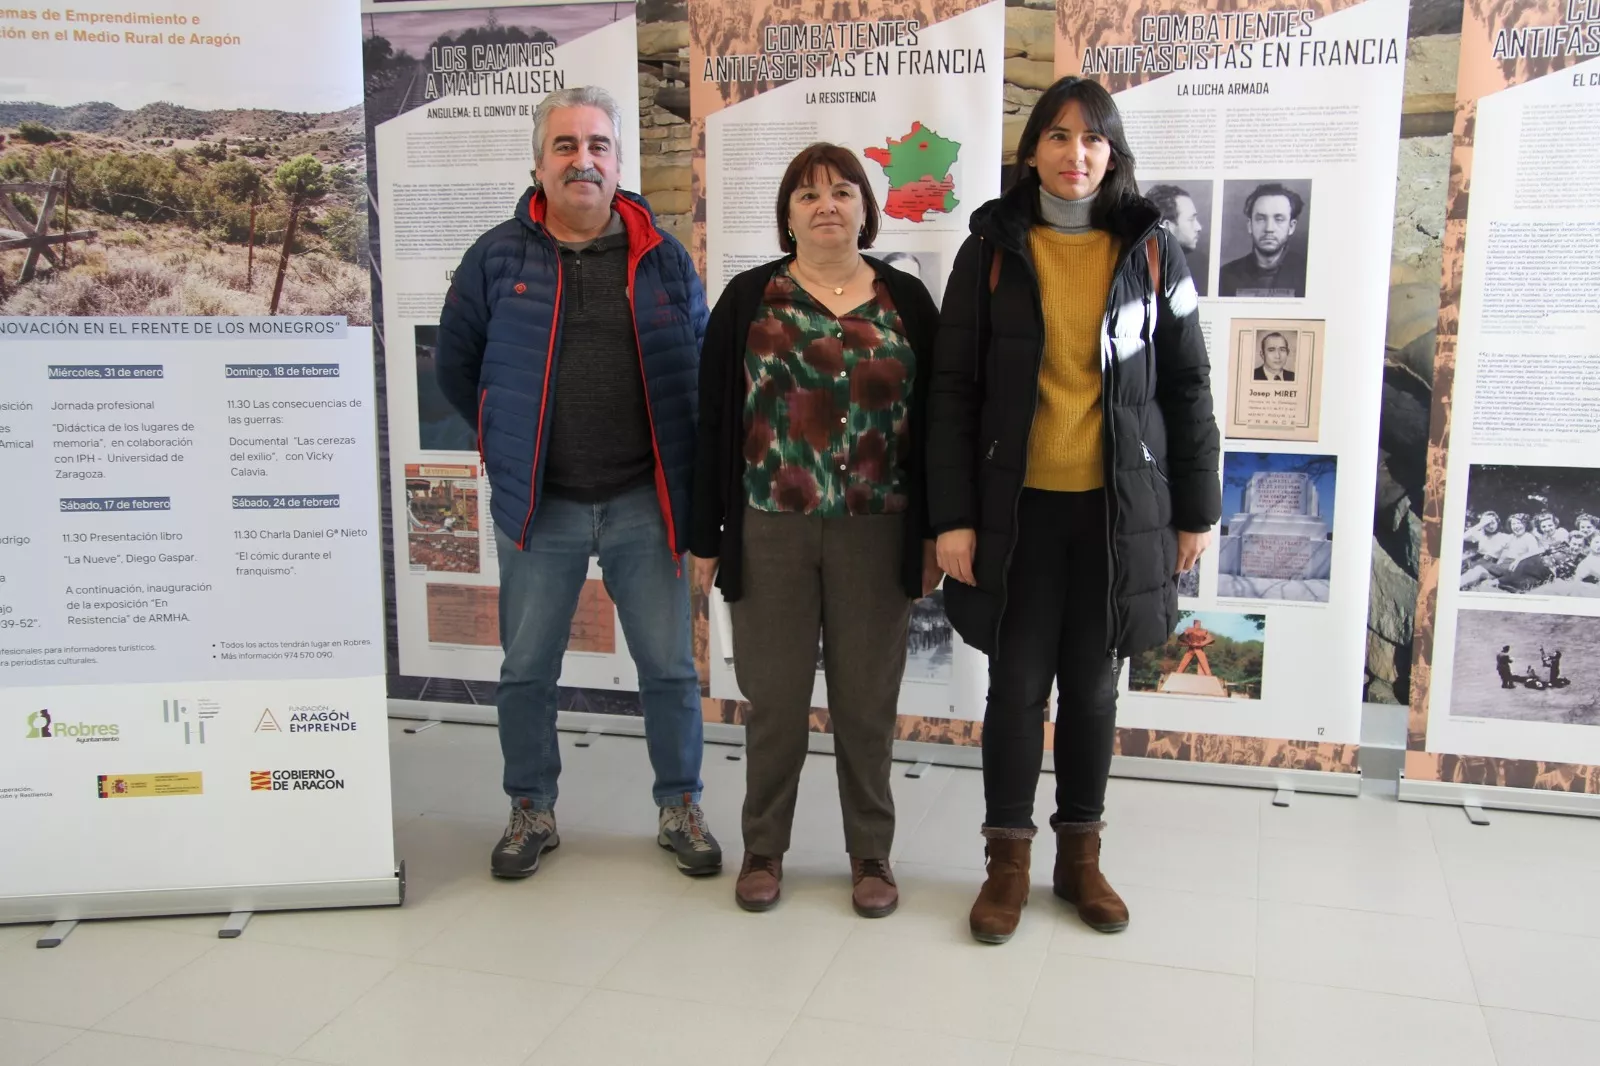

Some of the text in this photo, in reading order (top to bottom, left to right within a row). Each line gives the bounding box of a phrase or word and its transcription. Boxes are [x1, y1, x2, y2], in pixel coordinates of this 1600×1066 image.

[42, 8, 60, 21] de
[66, 10, 187, 25] Emprendimiento
[192, 16, 200, 24] e
[1142, 10, 1314, 42] COMBATIENTES
[0, 28, 240, 47] ión en el Medio Rural de Aragón
[766, 20, 919, 52] COMBATIENTES
[432, 42, 556, 72] LOS CAMINOS
[1082, 38, 1398, 74] ANTIFASCISTAS EN FRANCIA
[702, 48, 986, 82] ANTIFASCISTAS EN FRANCIA
[424, 69, 564, 98] A MAUTHAUSEN
[1573, 74, 1585, 86] EL
[1177, 82, 1269, 96] LA LUCHA ARMADA
[806, 91, 876, 104] LA RESISTENCIA
[427, 105, 530, 118] ANGULEMA: EL CONVOY DE
[84, 322, 104, 334] EN
[110, 322, 126, 334] EL
[132, 322, 189, 334] FRENTE
[194, 322, 212, 334] DE
[218, 322, 244, 334] LOS
[250, 322, 340, 334] MONEGROS"
[49, 367, 102, 378] Miércoles,
[104, 368, 116, 376] 31
[118, 368, 130, 376] de
[226, 366, 340, 378] Domingo, 18 de febrero
[1249, 389, 1298, 398] Josep MIRET
[0, 401, 32, 410] sición
[51, 401, 154, 412] Jornada profesional
[228, 398, 362, 408] 11.30 Las consecuencias de
[228, 416, 284, 426] las guerras:
[52, 423, 194, 434] "Didáctica de los lugares de
[126, 438, 192, 447] colaboración
[230, 437, 288, 446] Documental
[294, 437, 314, 446] "Las
[76, 454, 95, 463] IPH
[108, 454, 168, 463] Universidad
[171, 454, 184, 462] de
[230, 452, 245, 461] del
[306, 452, 334, 462] Vicky
[56, 470, 106, 480] Zaragoza.
[231, 468, 268, 476] Calavia.
[60, 500, 170, 510] Sábado, 17 de febrero
[232, 498, 340, 508] Sábado, 24 de febrero
[62, 532, 182, 542] 11.30 Presentación libro
[234, 528, 368, 538] 11.30 Charla Daniel Gª Nieto
[0, 535, 30, 546] drigo
[64, 556, 80, 564] "La
[126, 554, 156, 564] Diego
[158, 554, 197, 564] Gaspar.
[236, 552, 332, 560] "El cómic durante el
[236, 566, 296, 576] franquismo".
[66, 583, 212, 596] A continuación, inauguración
[66, 599, 168, 611] de la exposición "En
[0, 620, 40, 628] 39-52".
[68, 614, 190, 626] Resistencia" de ARMHA.
[280, 640, 310, 648] tendrán
[311, 640, 330, 649] lugar
[344, 639, 372, 647] Robres.
[0, 644, 156, 656] fesionales para informadores turísticos.
[221, 652, 237, 660] Más
[238, 652, 282, 660] información
[10, 656, 98, 668] periodistas culturales.
[290, 710, 350, 722] ARAGÓN
[54, 722, 120, 737] Robres
[290, 722, 356, 733] EMPRENDE
[1318, 728, 1324, 736] 12
[272, 769, 334, 780] GOBIERNO
[273, 780, 344, 790] DE ARAGON
